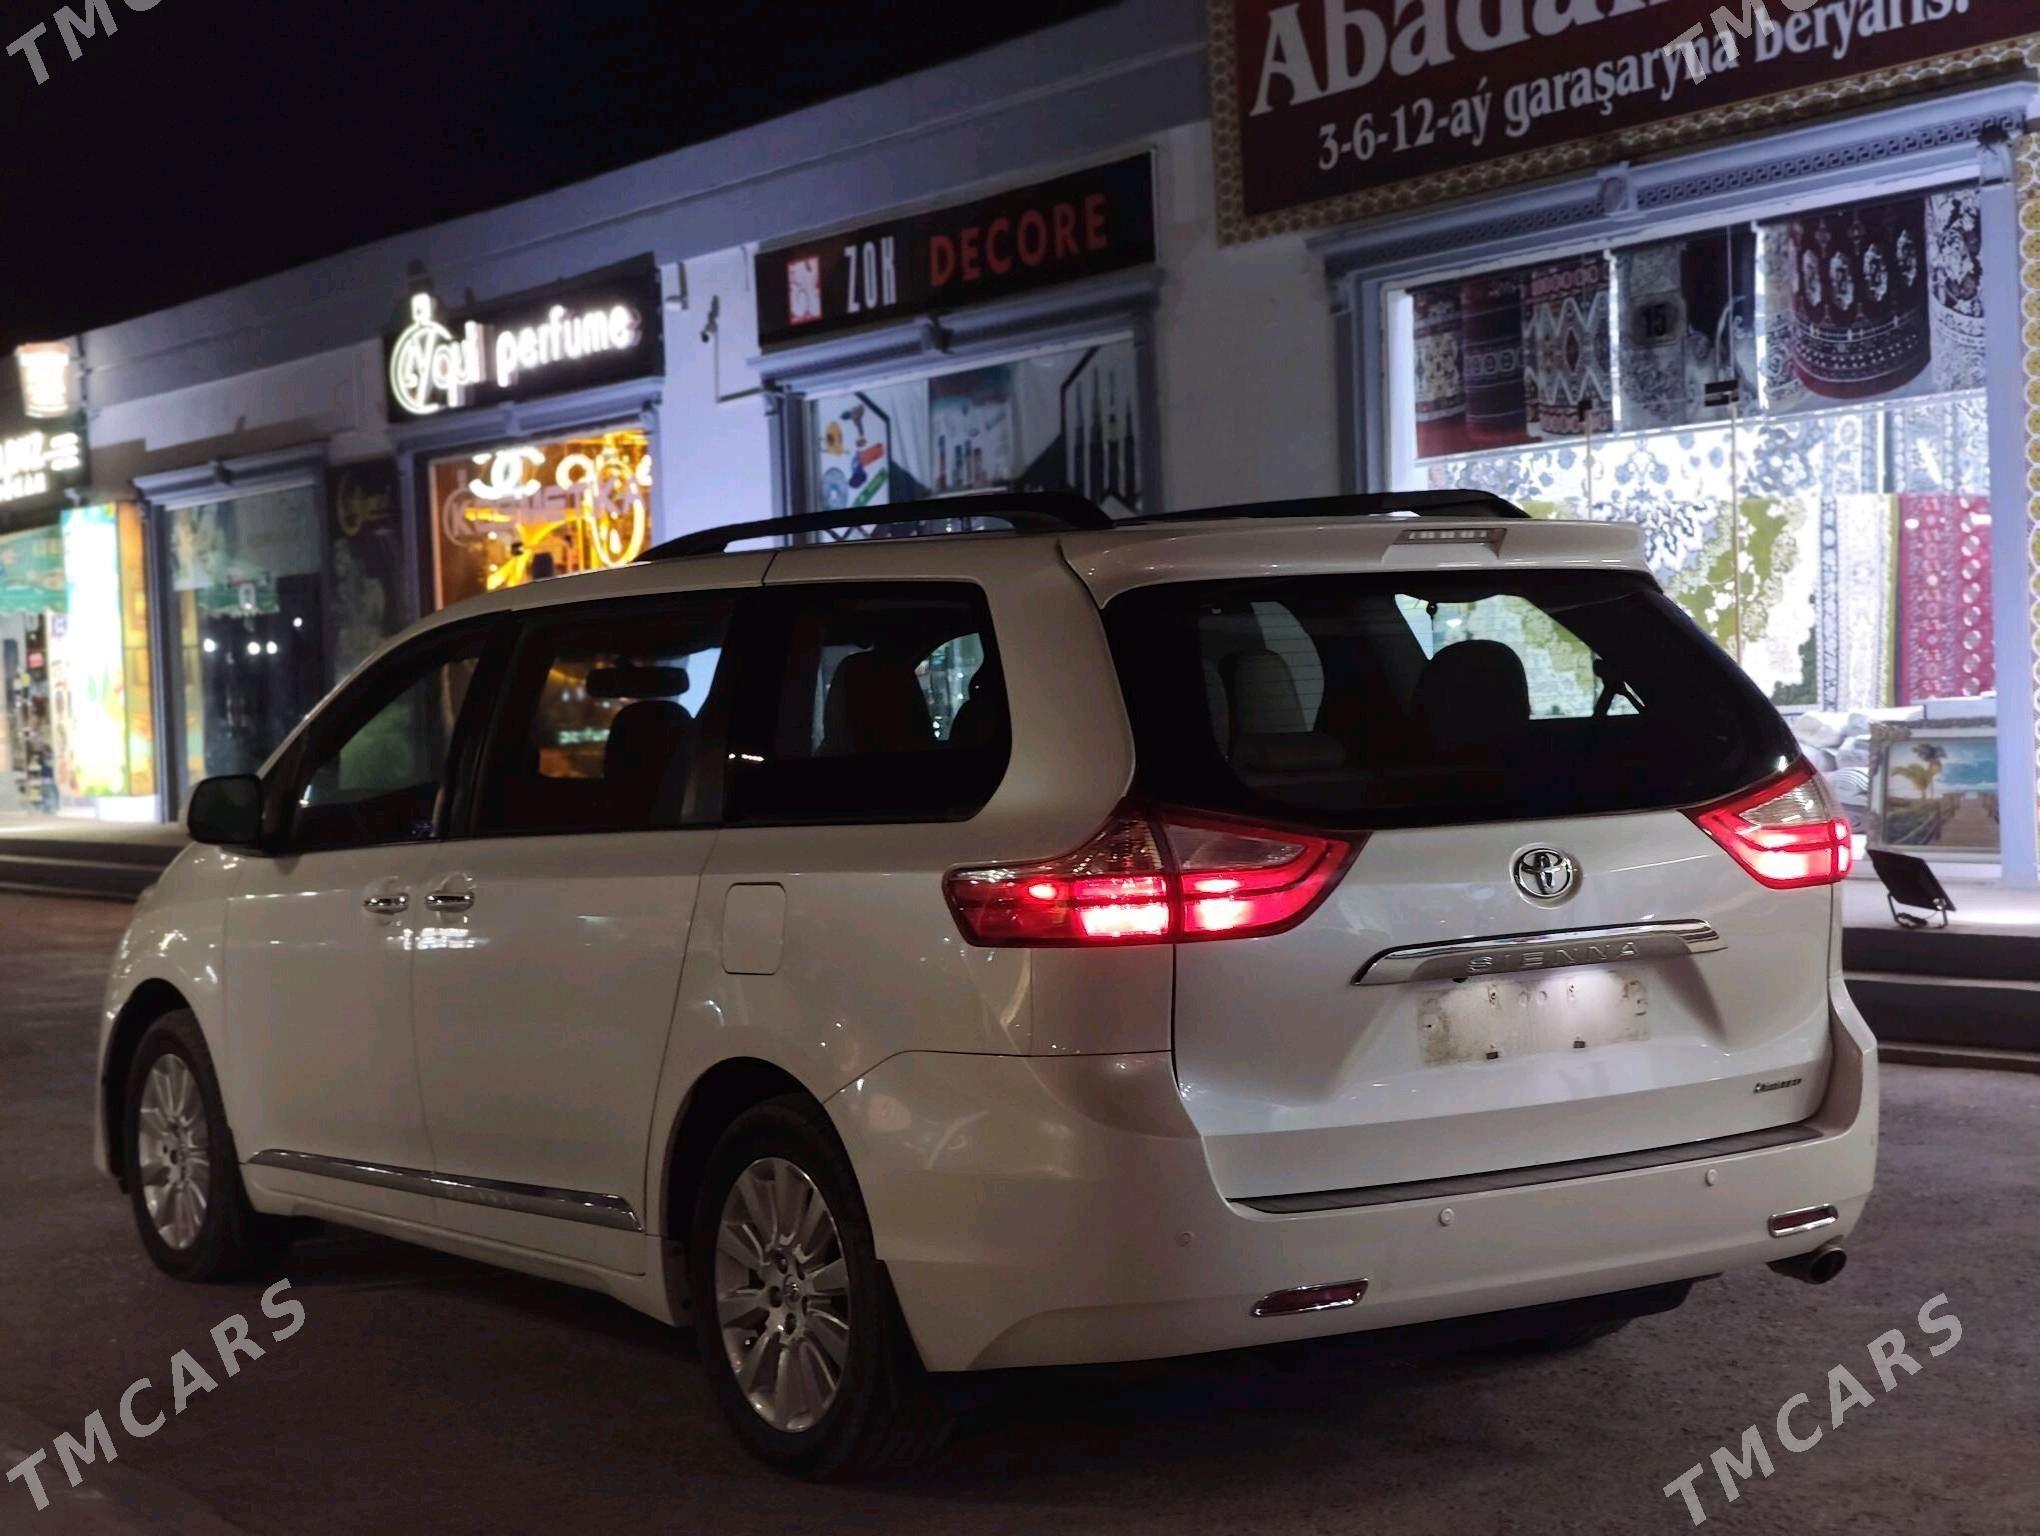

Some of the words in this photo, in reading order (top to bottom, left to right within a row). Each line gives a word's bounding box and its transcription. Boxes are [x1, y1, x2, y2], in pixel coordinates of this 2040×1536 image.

[1317, 77, 1492, 171] 3-6-12-aý
[929, 194, 1108, 287] DECORE
[495, 304, 634, 389] perfume
[1467, 942, 1641, 973] SIENNA
